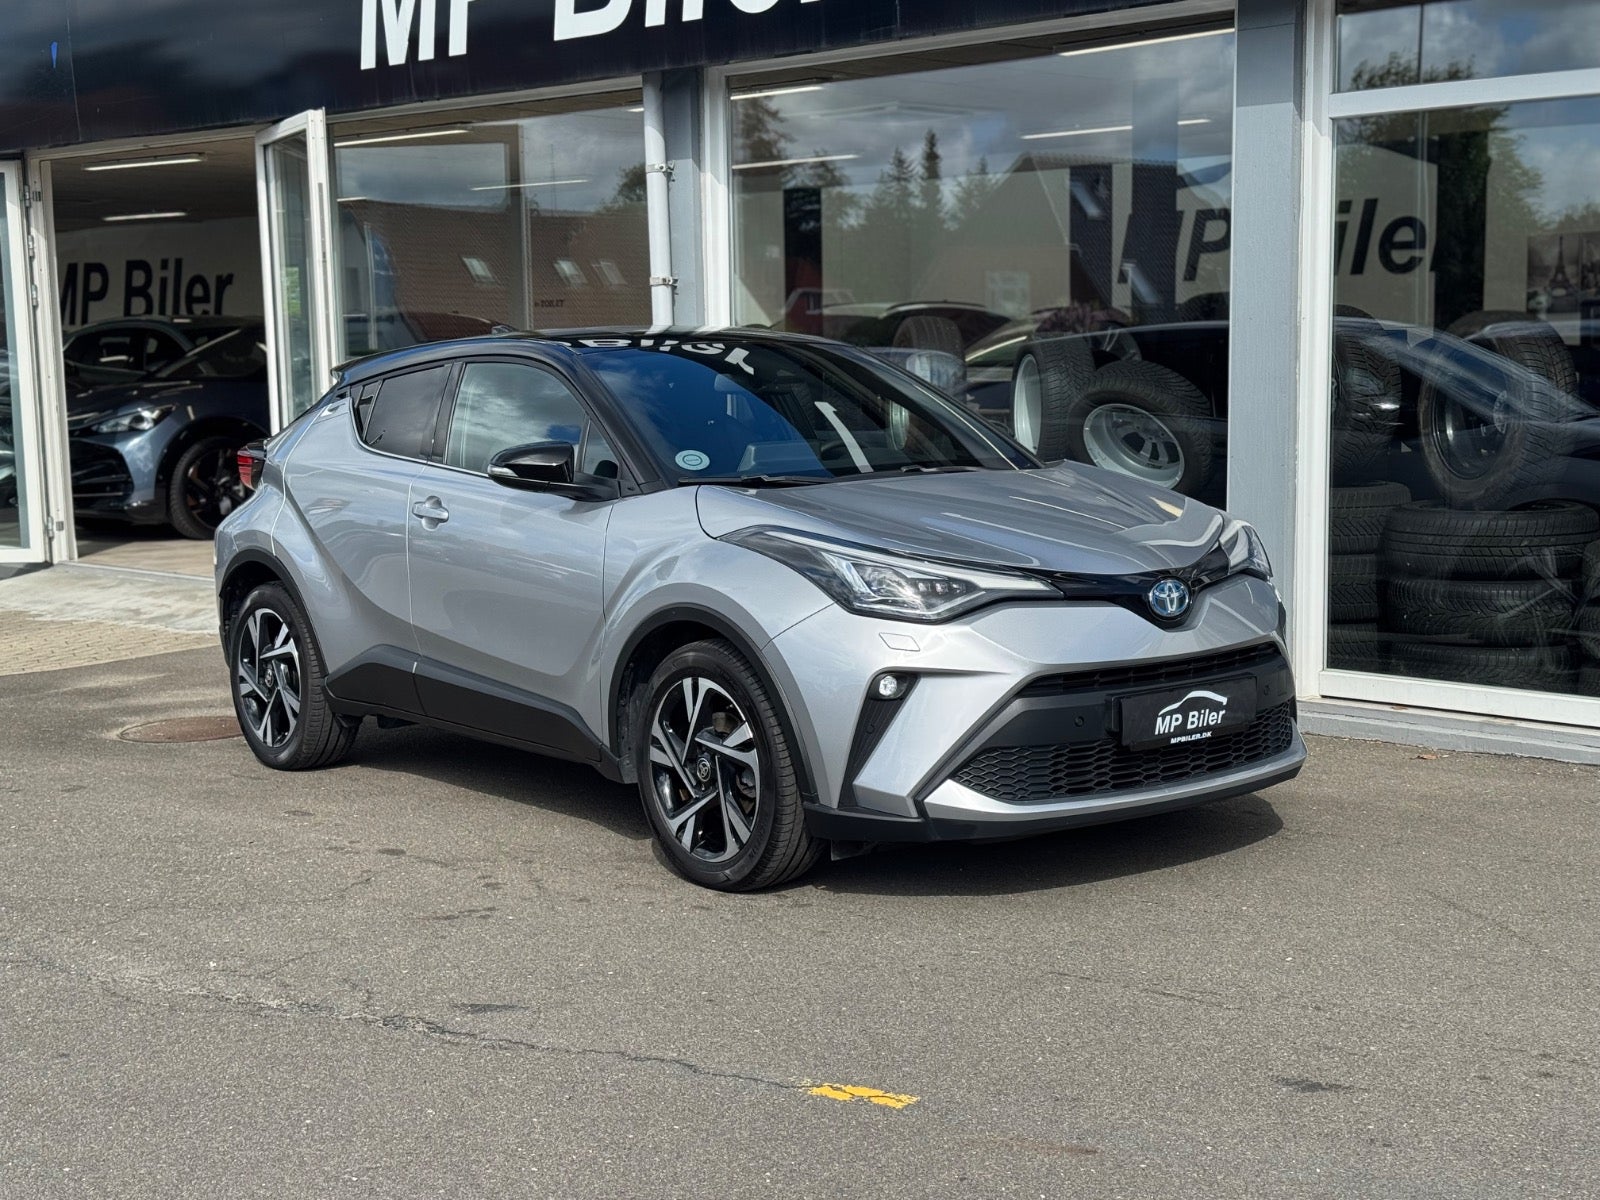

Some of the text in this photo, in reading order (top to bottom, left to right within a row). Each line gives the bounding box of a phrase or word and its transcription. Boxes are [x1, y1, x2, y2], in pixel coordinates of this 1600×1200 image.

[123, 257, 234, 317] Biler
[1154, 708, 1226, 735] MP Biler
[1170, 731, 1212, 744] MPBILER.DK
